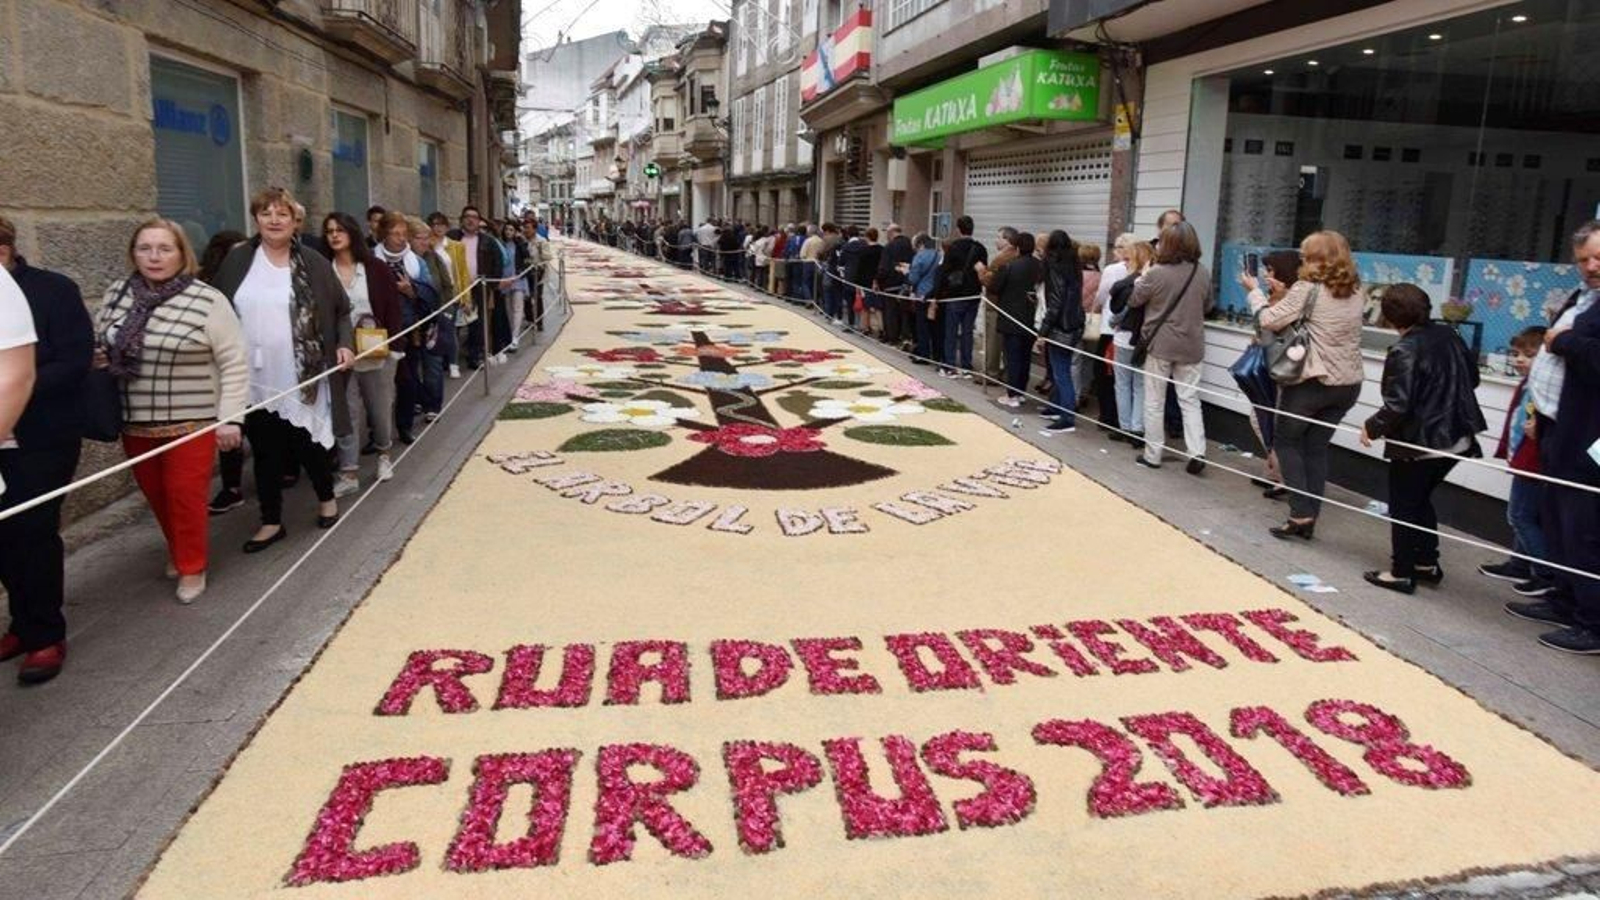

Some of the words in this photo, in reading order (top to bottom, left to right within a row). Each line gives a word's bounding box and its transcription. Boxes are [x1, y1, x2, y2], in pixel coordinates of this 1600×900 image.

[1049, 58, 1085, 72] Frutas
[532, 471, 754, 535] ARBOL
[774, 504, 871, 537] DE
[373, 640, 692, 716] RUA
[709, 637, 882, 700] DE
[283, 729, 1038, 889] CORPUS
[1031, 699, 1474, 819] 2018
